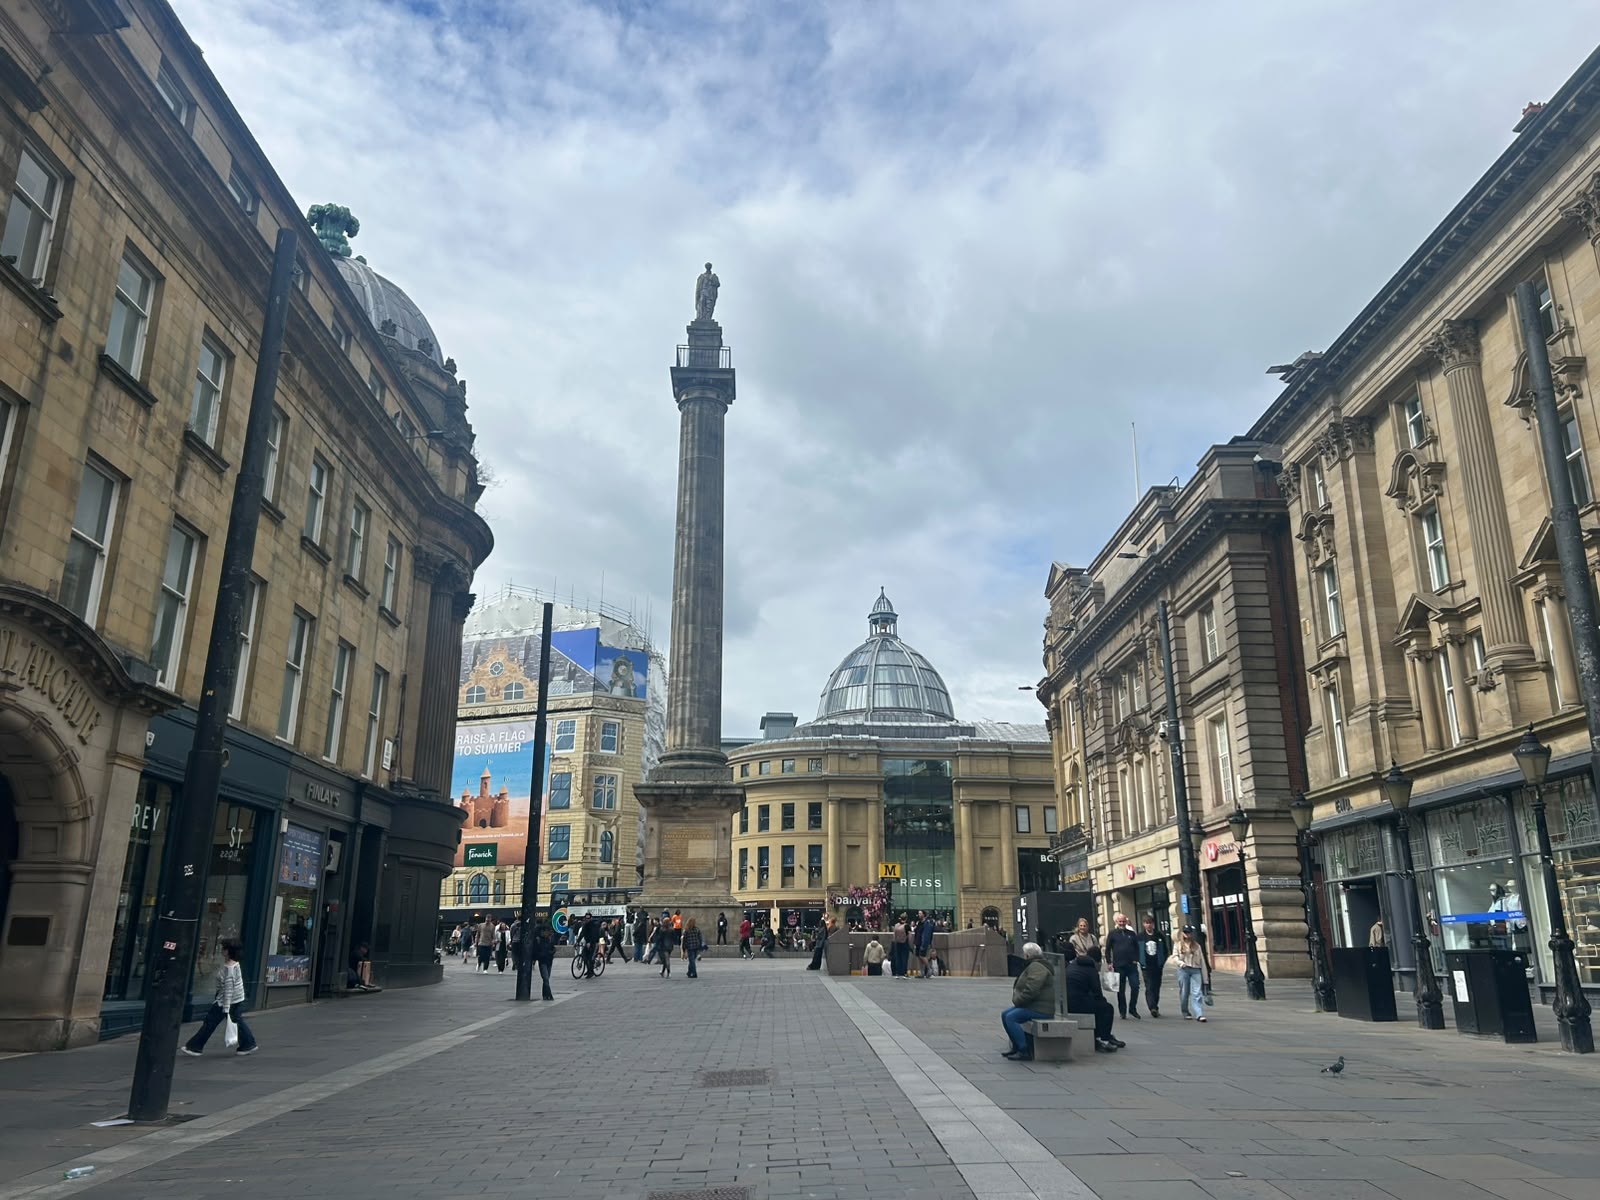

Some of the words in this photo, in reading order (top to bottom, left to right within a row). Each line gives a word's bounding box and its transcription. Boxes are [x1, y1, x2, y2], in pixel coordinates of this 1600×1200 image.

[457, 732, 487, 745] RAISE
[488, 733, 496, 743] A
[499, 730, 526, 741] FLAG
[458, 745, 472, 756] TO
[474, 742, 522, 755] SUMMER
[306, 782, 341, 808] FINLAY'S
[229, 826, 244, 850] ST.
[468, 848, 493, 861] Fenwick
[884, 864, 897, 876] M
[900, 878, 942, 888] REISS
